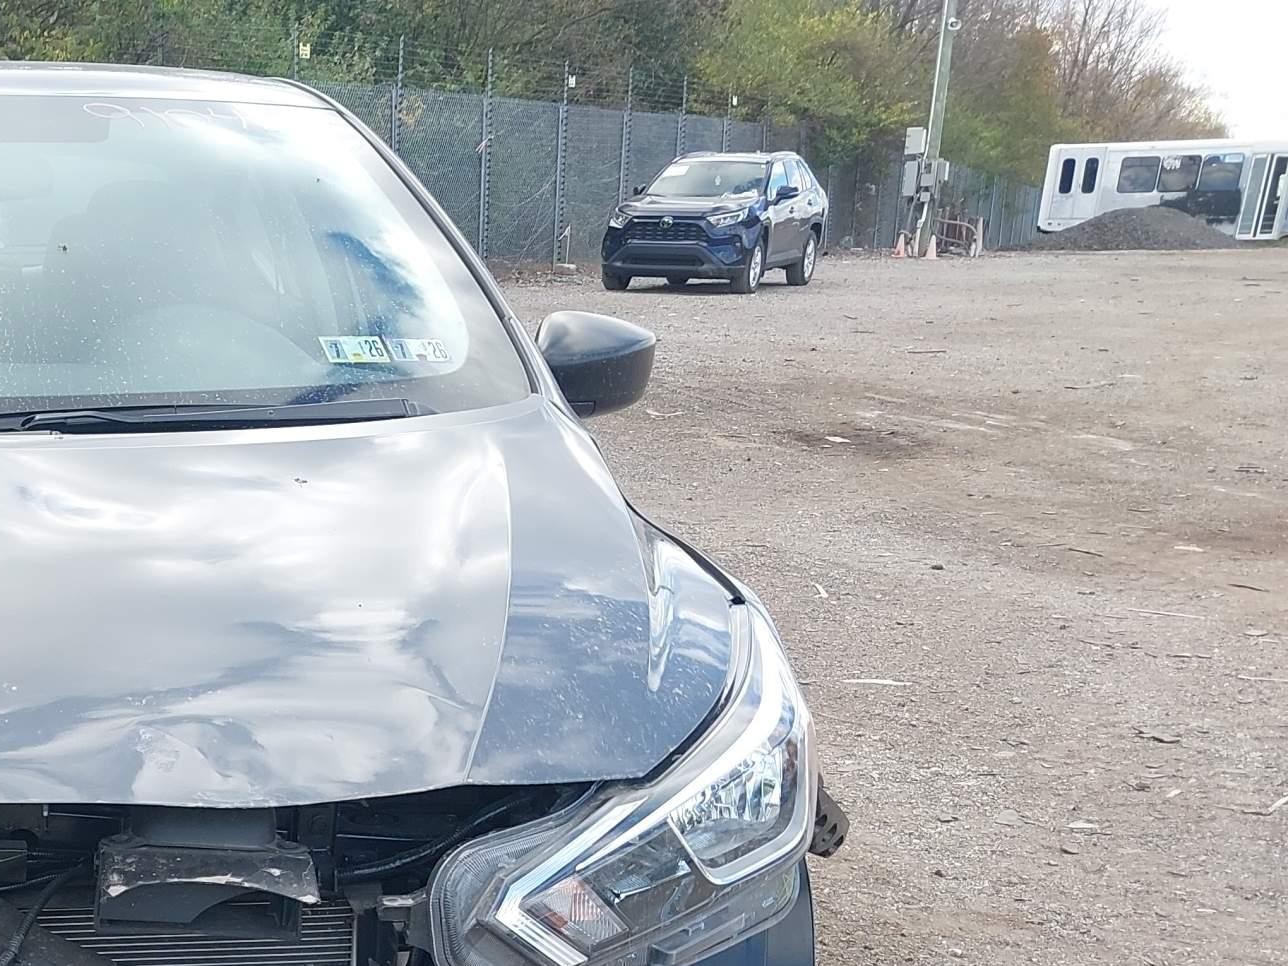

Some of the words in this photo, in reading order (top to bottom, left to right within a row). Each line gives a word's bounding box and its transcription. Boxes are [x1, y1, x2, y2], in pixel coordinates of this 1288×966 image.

[329, 342, 342, 359] 7
[364, 340, 385, 357] 26
[394, 342, 408, 359] 7
[428, 341, 448, 359] 26
